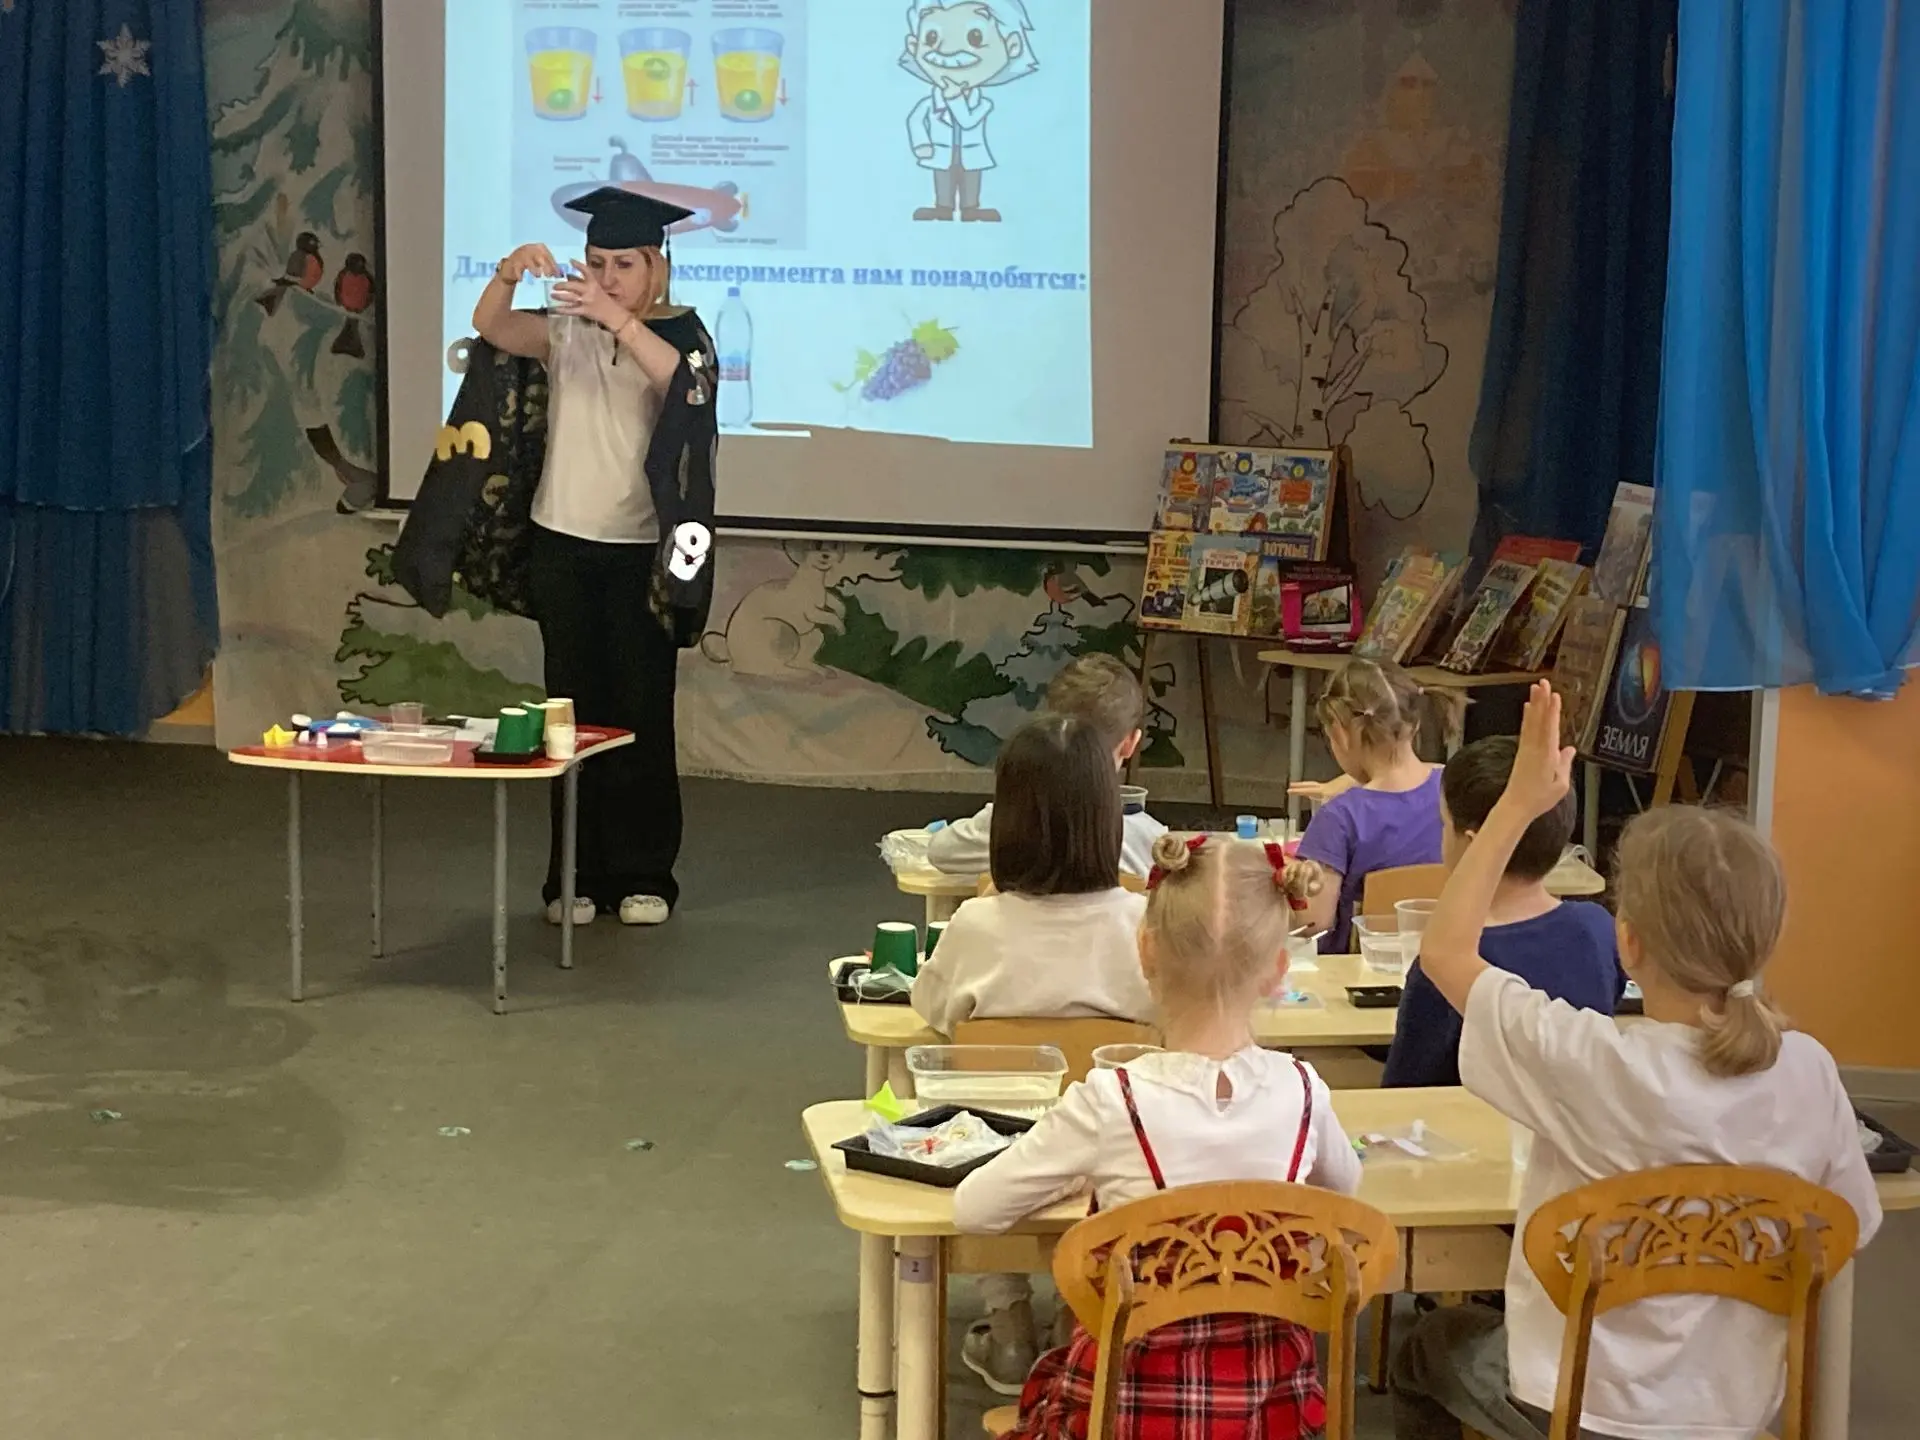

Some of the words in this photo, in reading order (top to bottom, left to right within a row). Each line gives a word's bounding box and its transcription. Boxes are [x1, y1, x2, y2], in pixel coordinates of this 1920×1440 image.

[852, 267, 904, 286] нам
[910, 265, 1087, 291] понадобятся:
[1599, 725, 1650, 759] ЗЕМЛЯ
